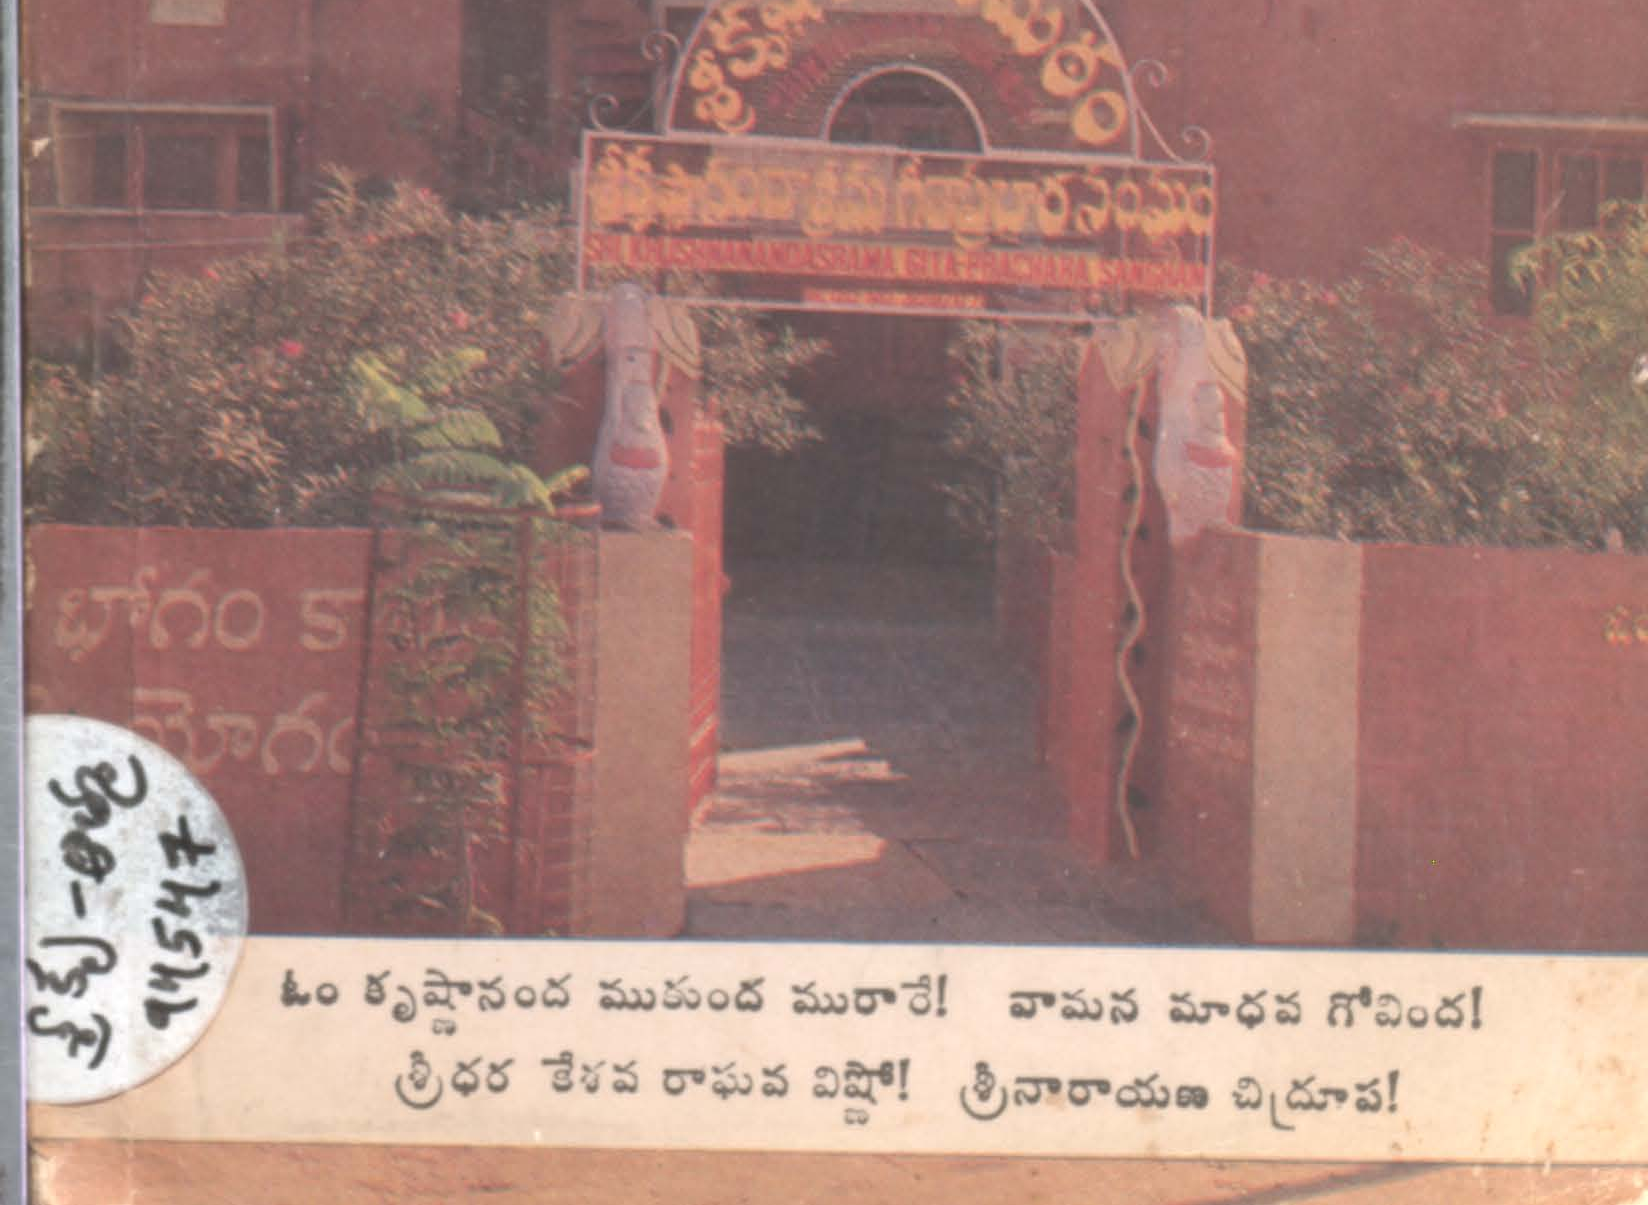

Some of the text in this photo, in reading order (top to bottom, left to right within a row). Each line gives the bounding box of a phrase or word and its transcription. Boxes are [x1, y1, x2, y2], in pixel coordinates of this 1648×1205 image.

[280, 968, 1484, 1036] ఓం కృష్ణానంద ముకుంద మురారే! వామన మాధవ గోవింద!
[395, 1050, 515, 1110] శ్రీధర
[541, 1050, 639, 1094] కేశవ
[663, 1061, 790, 1100] రాఘవ
[959, 1061, 1210, 1121] శ్రీనారాయణ
[1232, 1069, 1400, 1131] చిద్రూప!
